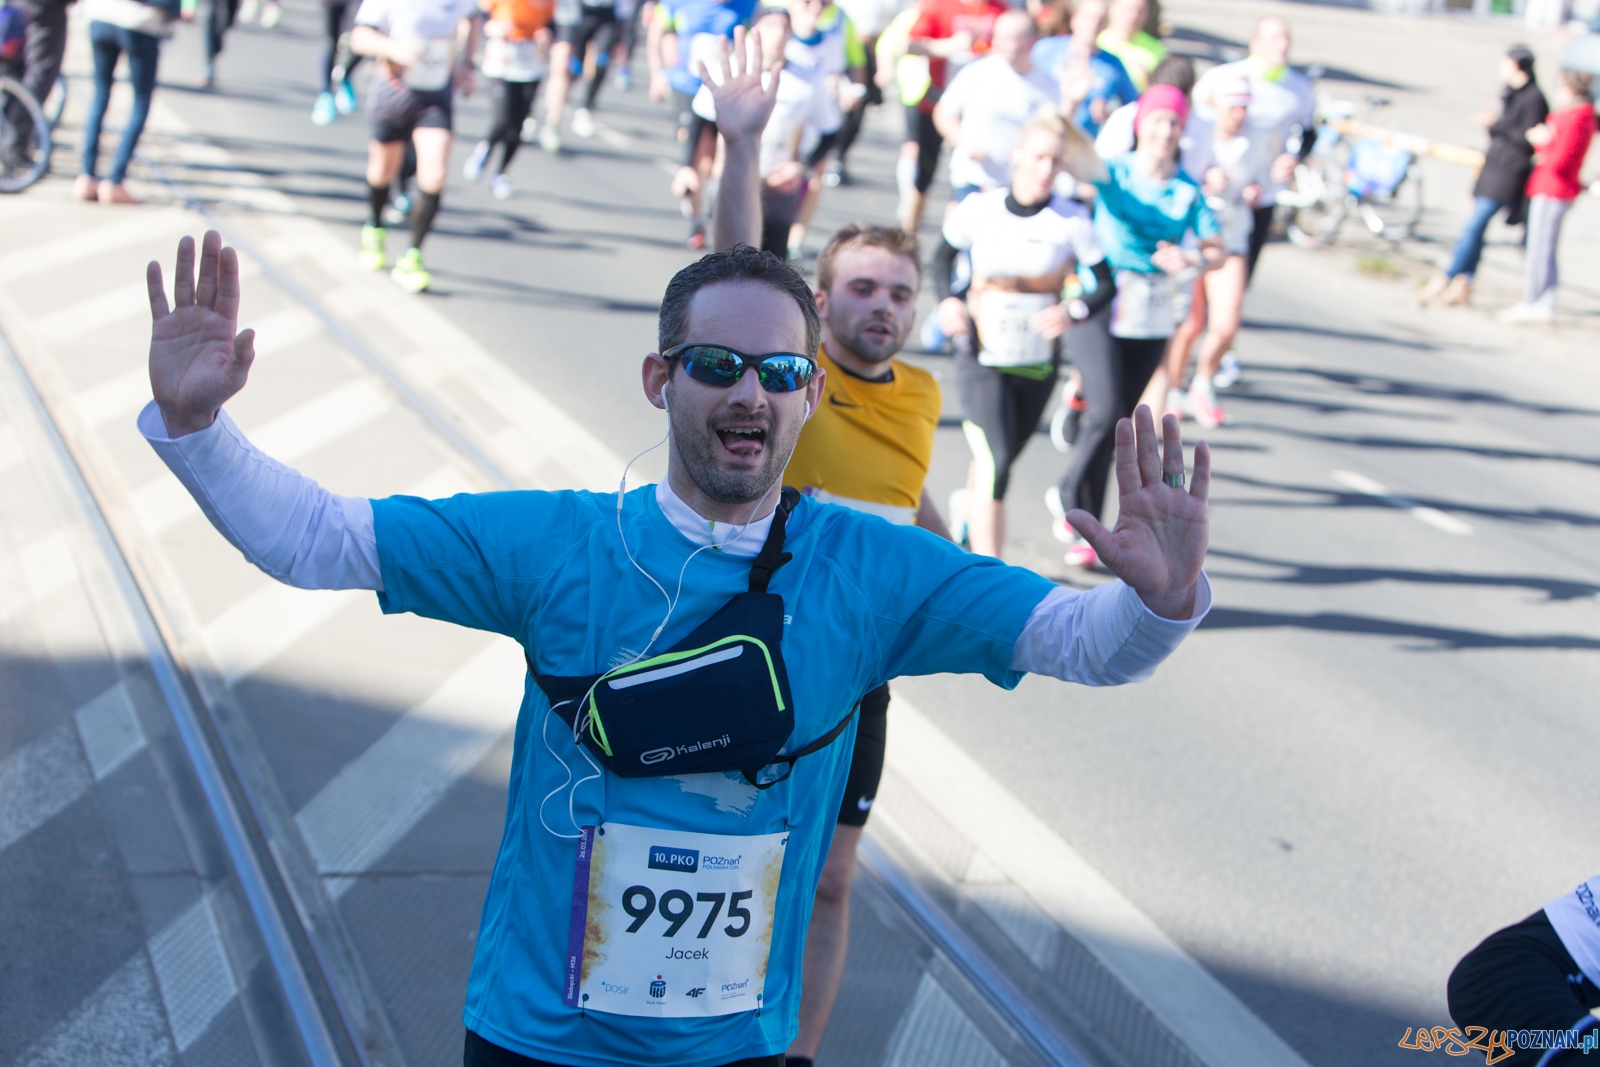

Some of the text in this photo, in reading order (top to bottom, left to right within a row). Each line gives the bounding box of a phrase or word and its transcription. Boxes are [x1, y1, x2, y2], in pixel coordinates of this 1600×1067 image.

[676, 734, 731, 756] Kalenji
[654, 852, 695, 866] 10. PKO
[621, 884, 753, 939] 9975
[665, 947, 710, 960] Jacek
[685, 987, 706, 998] 4F
